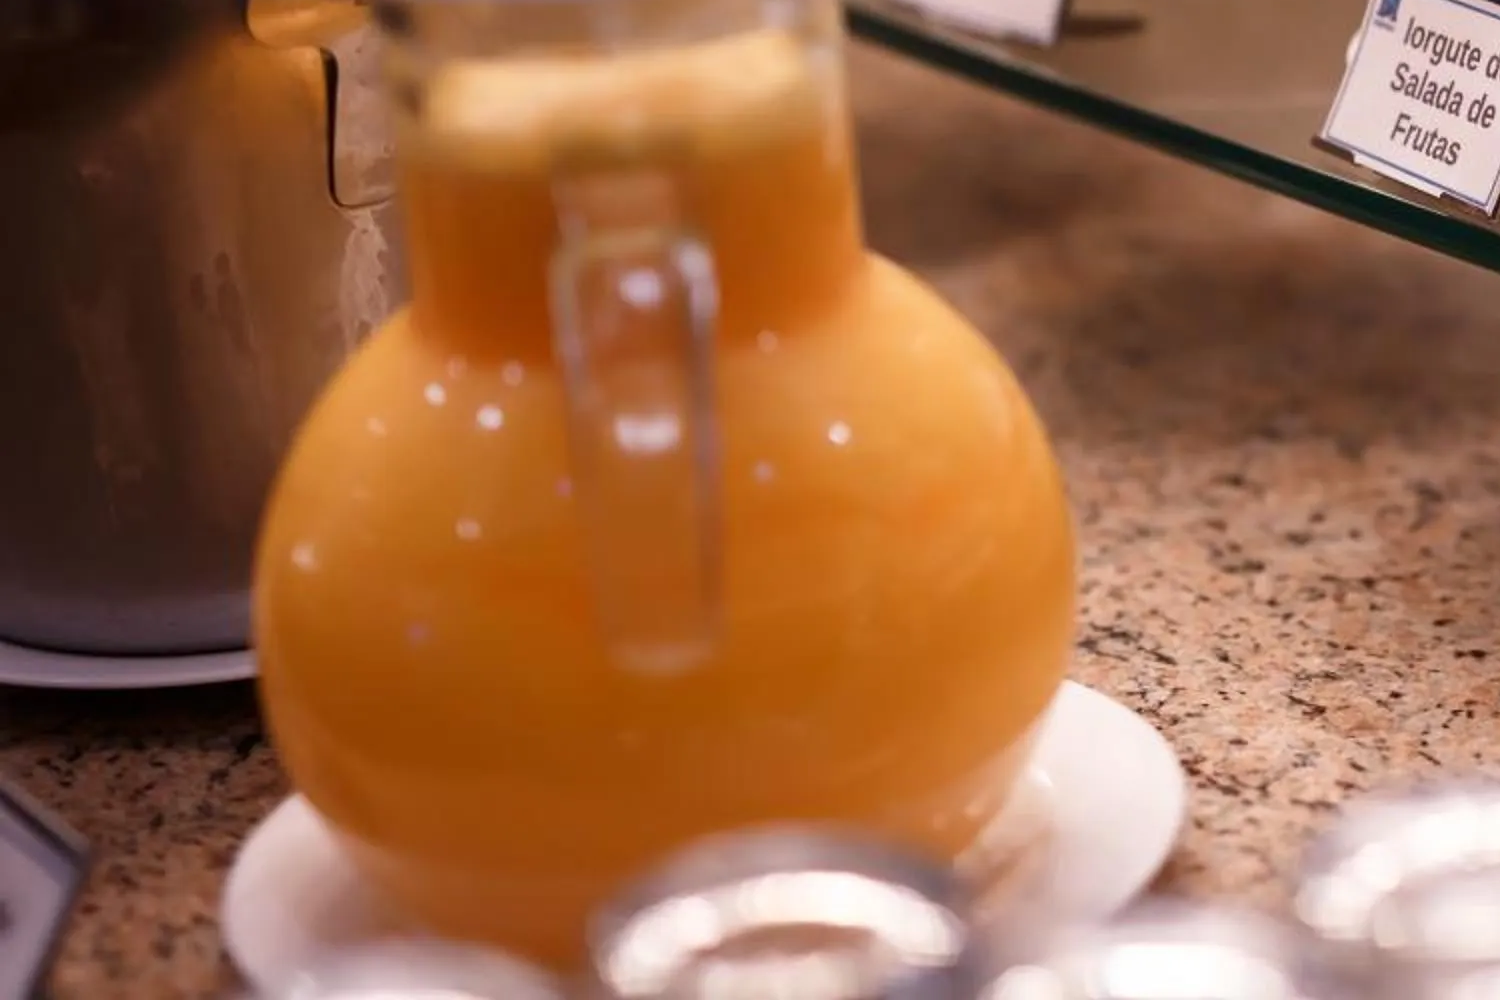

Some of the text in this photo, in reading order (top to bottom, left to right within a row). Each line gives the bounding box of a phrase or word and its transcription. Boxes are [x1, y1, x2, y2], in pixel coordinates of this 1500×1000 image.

[1403, 16, 1481, 72] Iorgute
[1390, 62, 1496, 129] Salada de
[1390, 113, 1462, 166] Frutas
